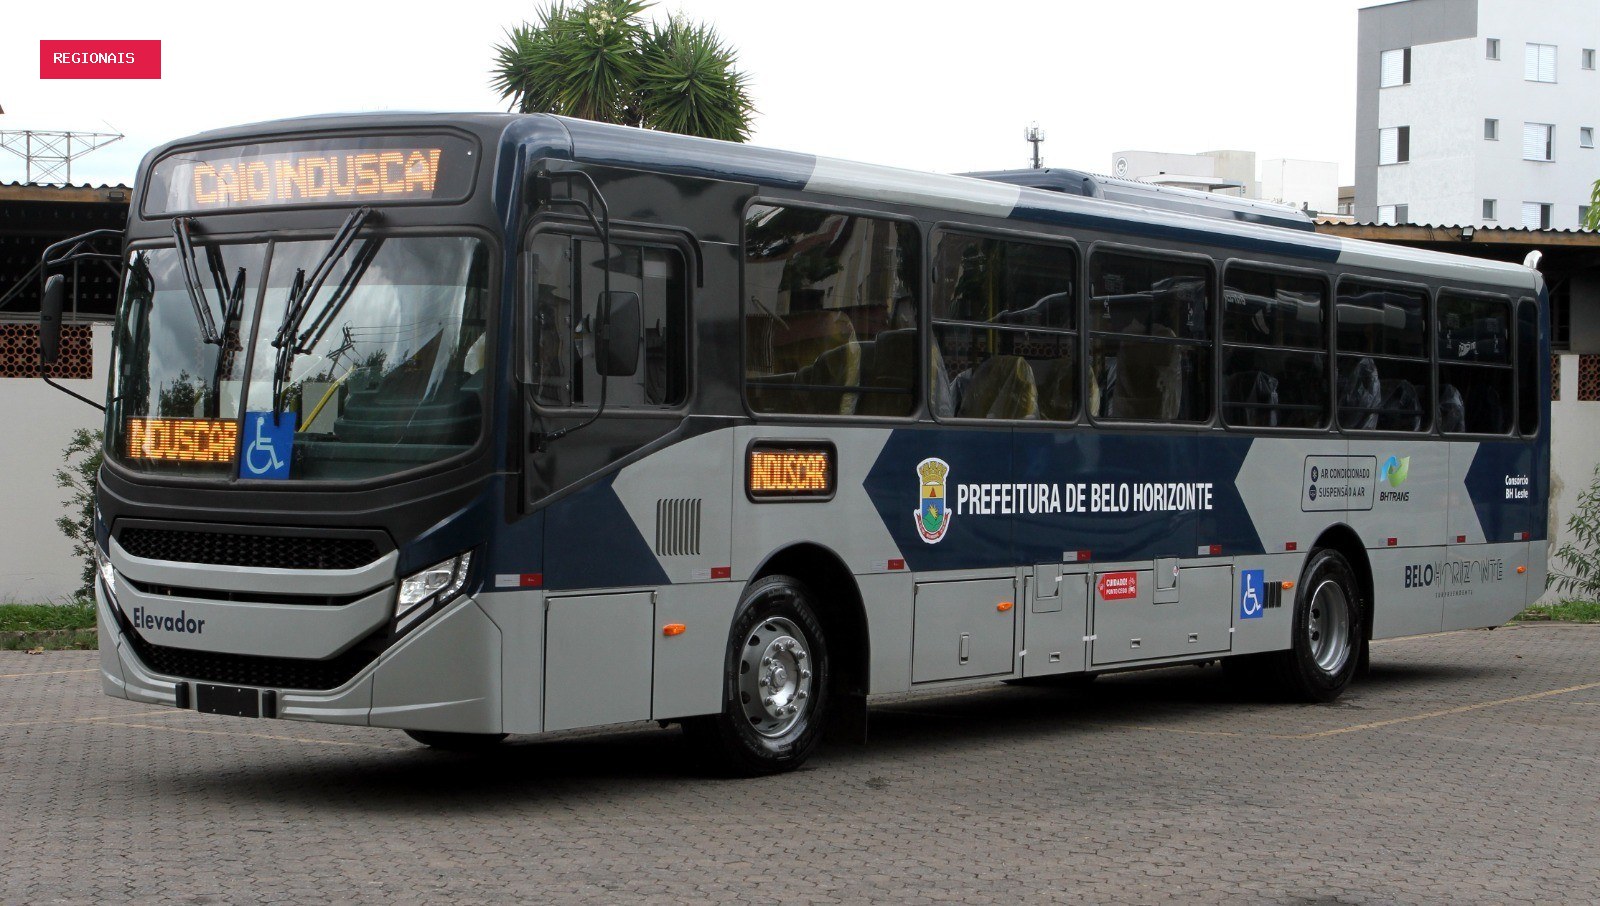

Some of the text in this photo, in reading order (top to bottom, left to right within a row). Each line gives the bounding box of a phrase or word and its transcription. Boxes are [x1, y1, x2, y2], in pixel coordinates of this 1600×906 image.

[194, 160, 271, 204] CAIO
[753, 454, 826, 489] INDUSCAR
[1320, 468, 1369, 480] AR CONDICIONADO
[1505, 474, 1529, 486] Consórcio
[1318, 484, 1365, 498] SUSPENSÃO A AR
[1379, 491, 1410, 502] BHTRANS
[1505, 488, 1529, 499] BH Leste
[957, 482, 1213, 515] PREFEITURA DE BELO HORIZONTE
[133, 607, 205, 634] Elevador
